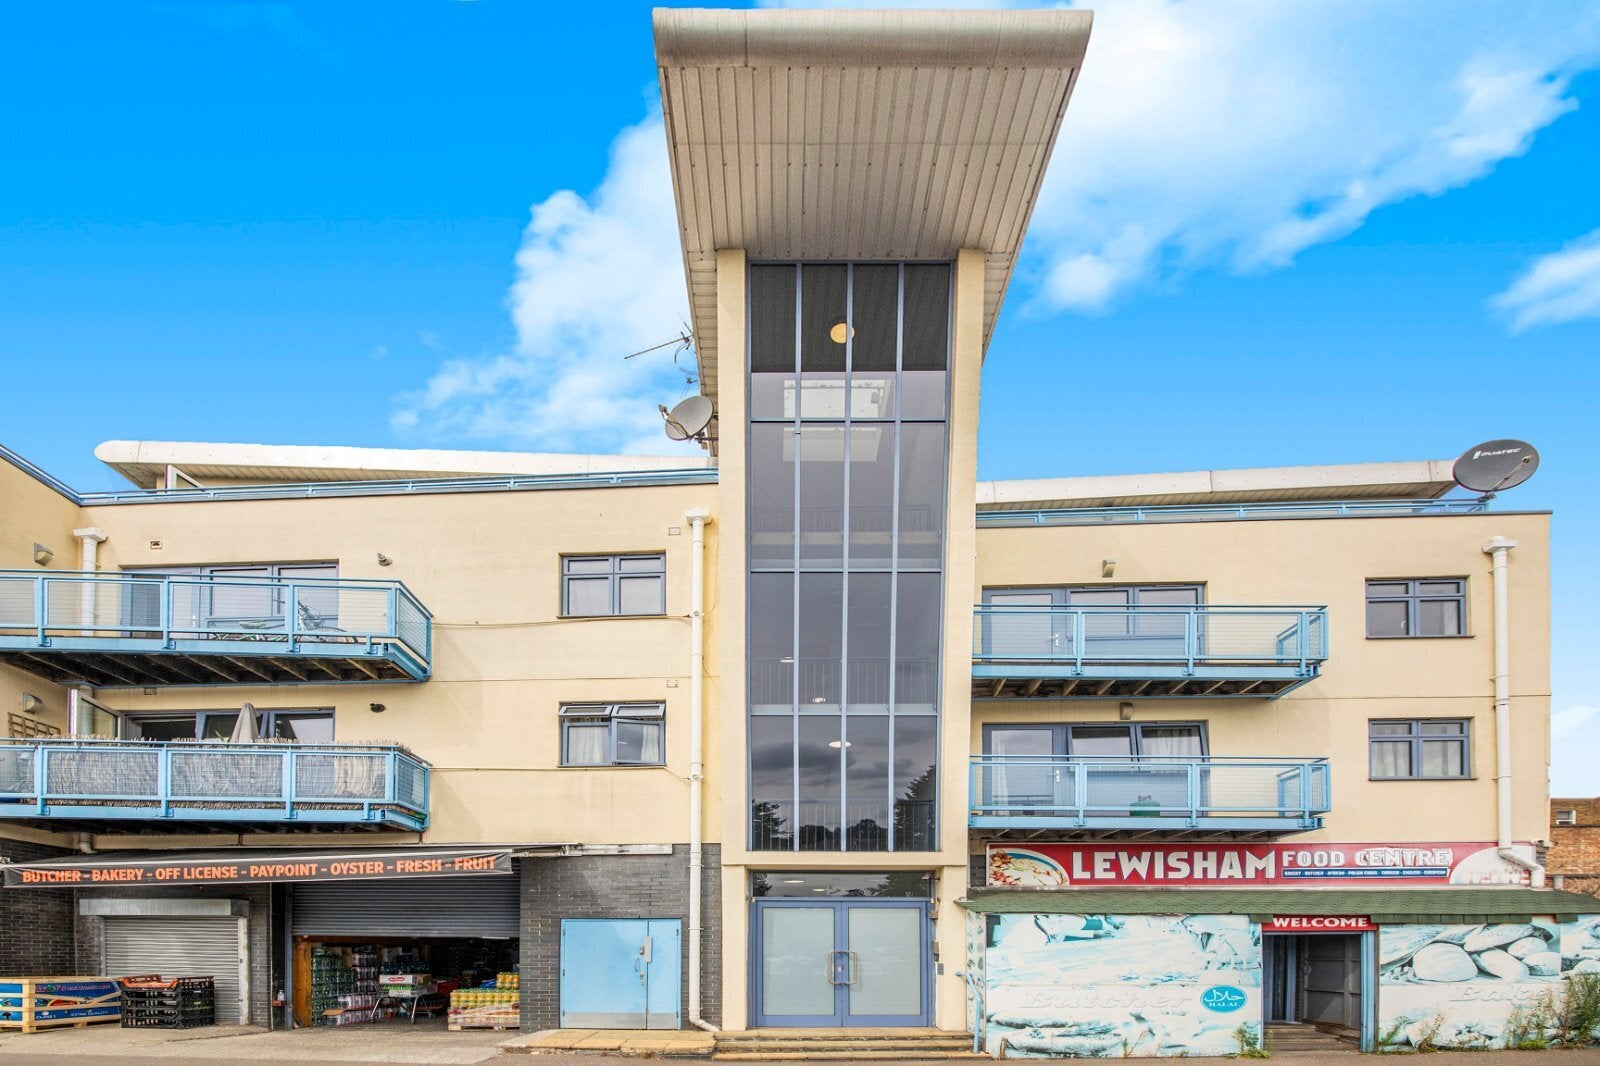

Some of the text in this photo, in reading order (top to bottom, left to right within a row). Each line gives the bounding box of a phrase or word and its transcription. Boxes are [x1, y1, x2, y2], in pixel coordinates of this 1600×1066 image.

[22, 856, 496, 883] BUTCHER BAKERY OFF LICENSE PAYPOINT OYSTER FRESH FRUIT
[1071, 847, 1454, 880] LEWISHAM FOOD CENTRE
[1273, 917, 1368, 928] WELCOME
[1017, 991, 1194, 1009] Butcher
